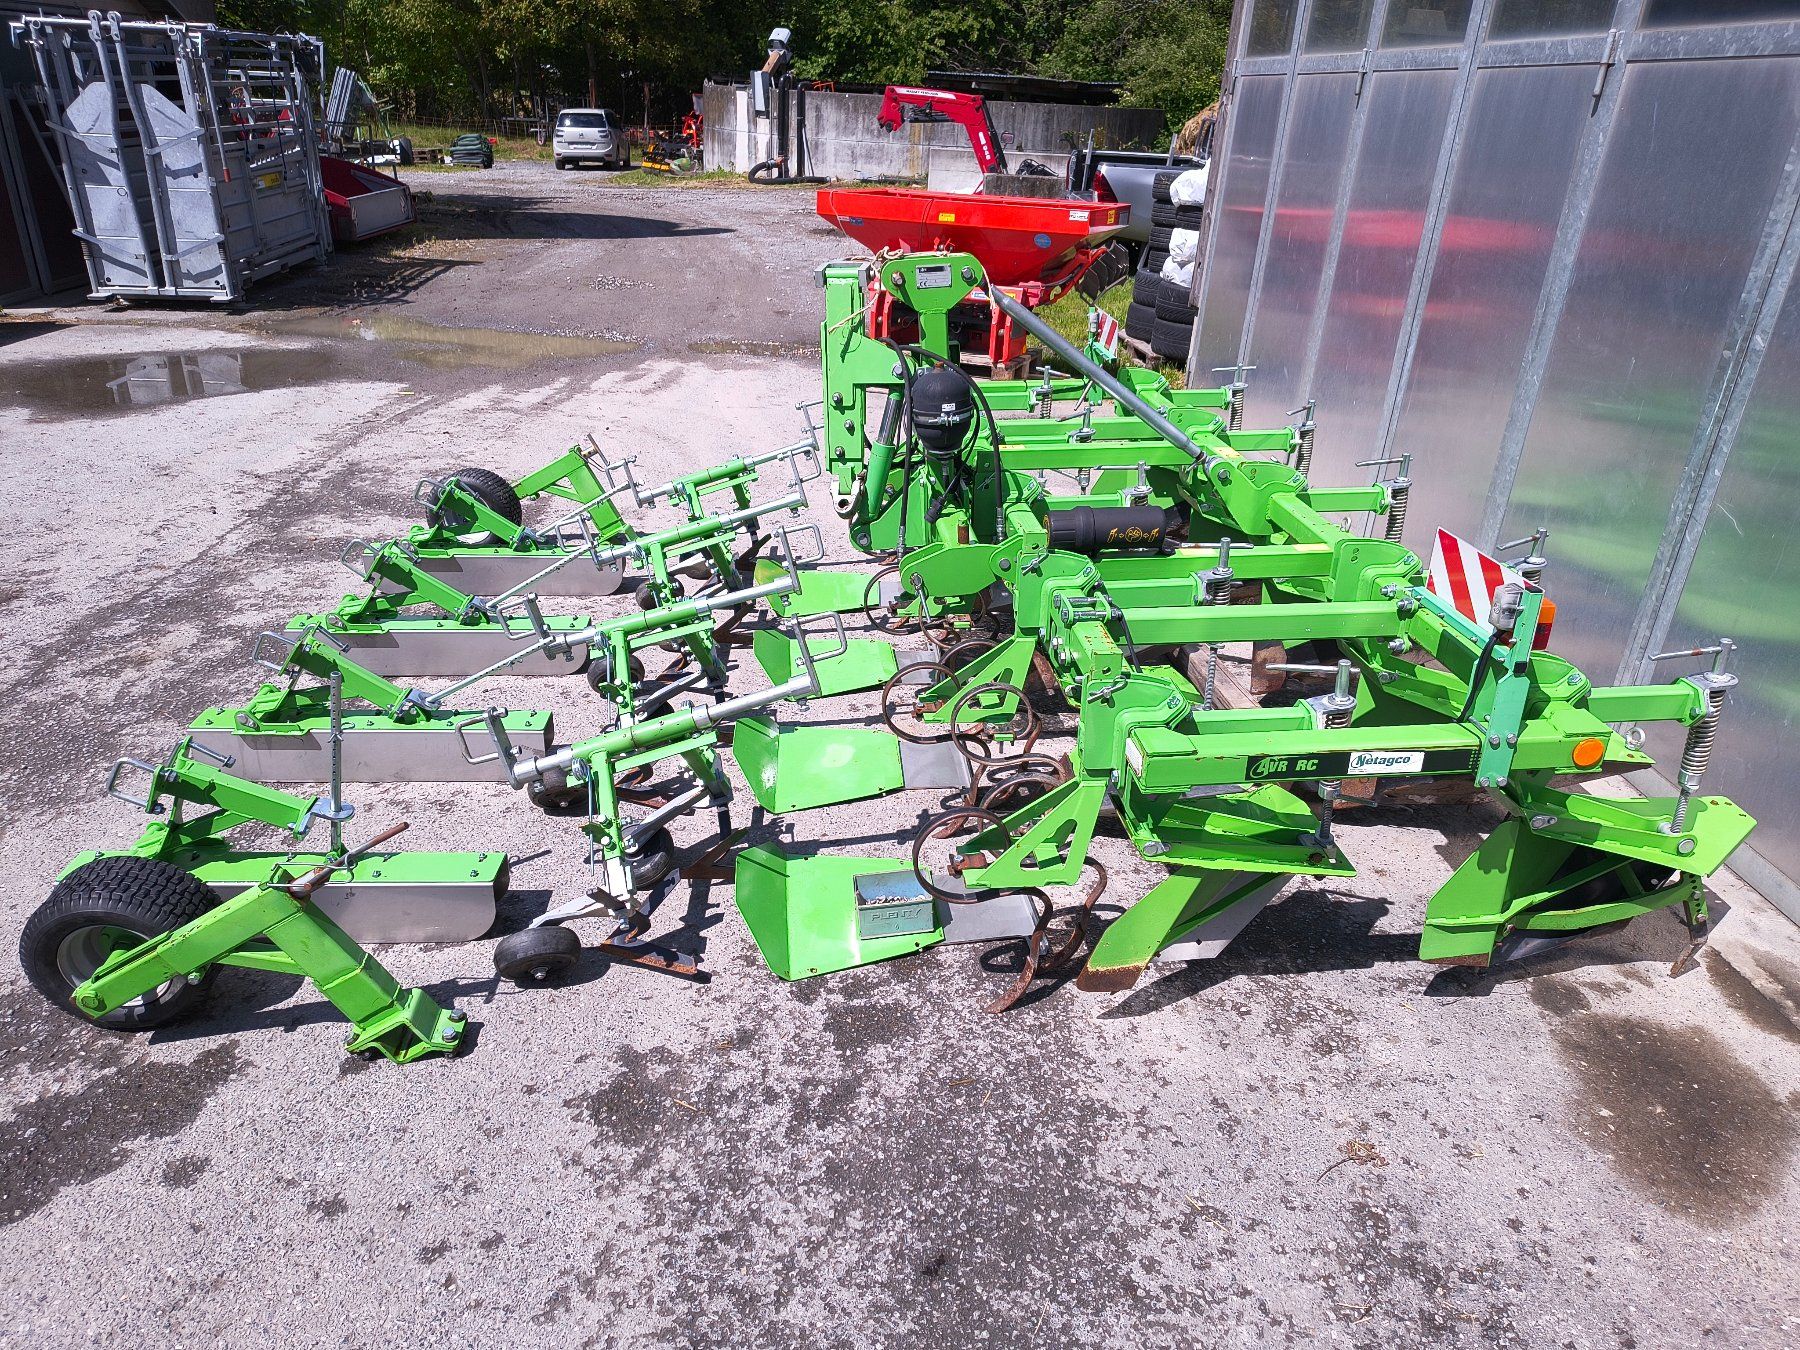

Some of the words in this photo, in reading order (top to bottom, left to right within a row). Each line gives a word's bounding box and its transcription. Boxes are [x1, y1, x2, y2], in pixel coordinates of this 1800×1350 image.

[1251, 757, 1288, 777] AVR
[1295, 759, 1319, 771] RC
[1352, 754, 1411, 768] Netagco
